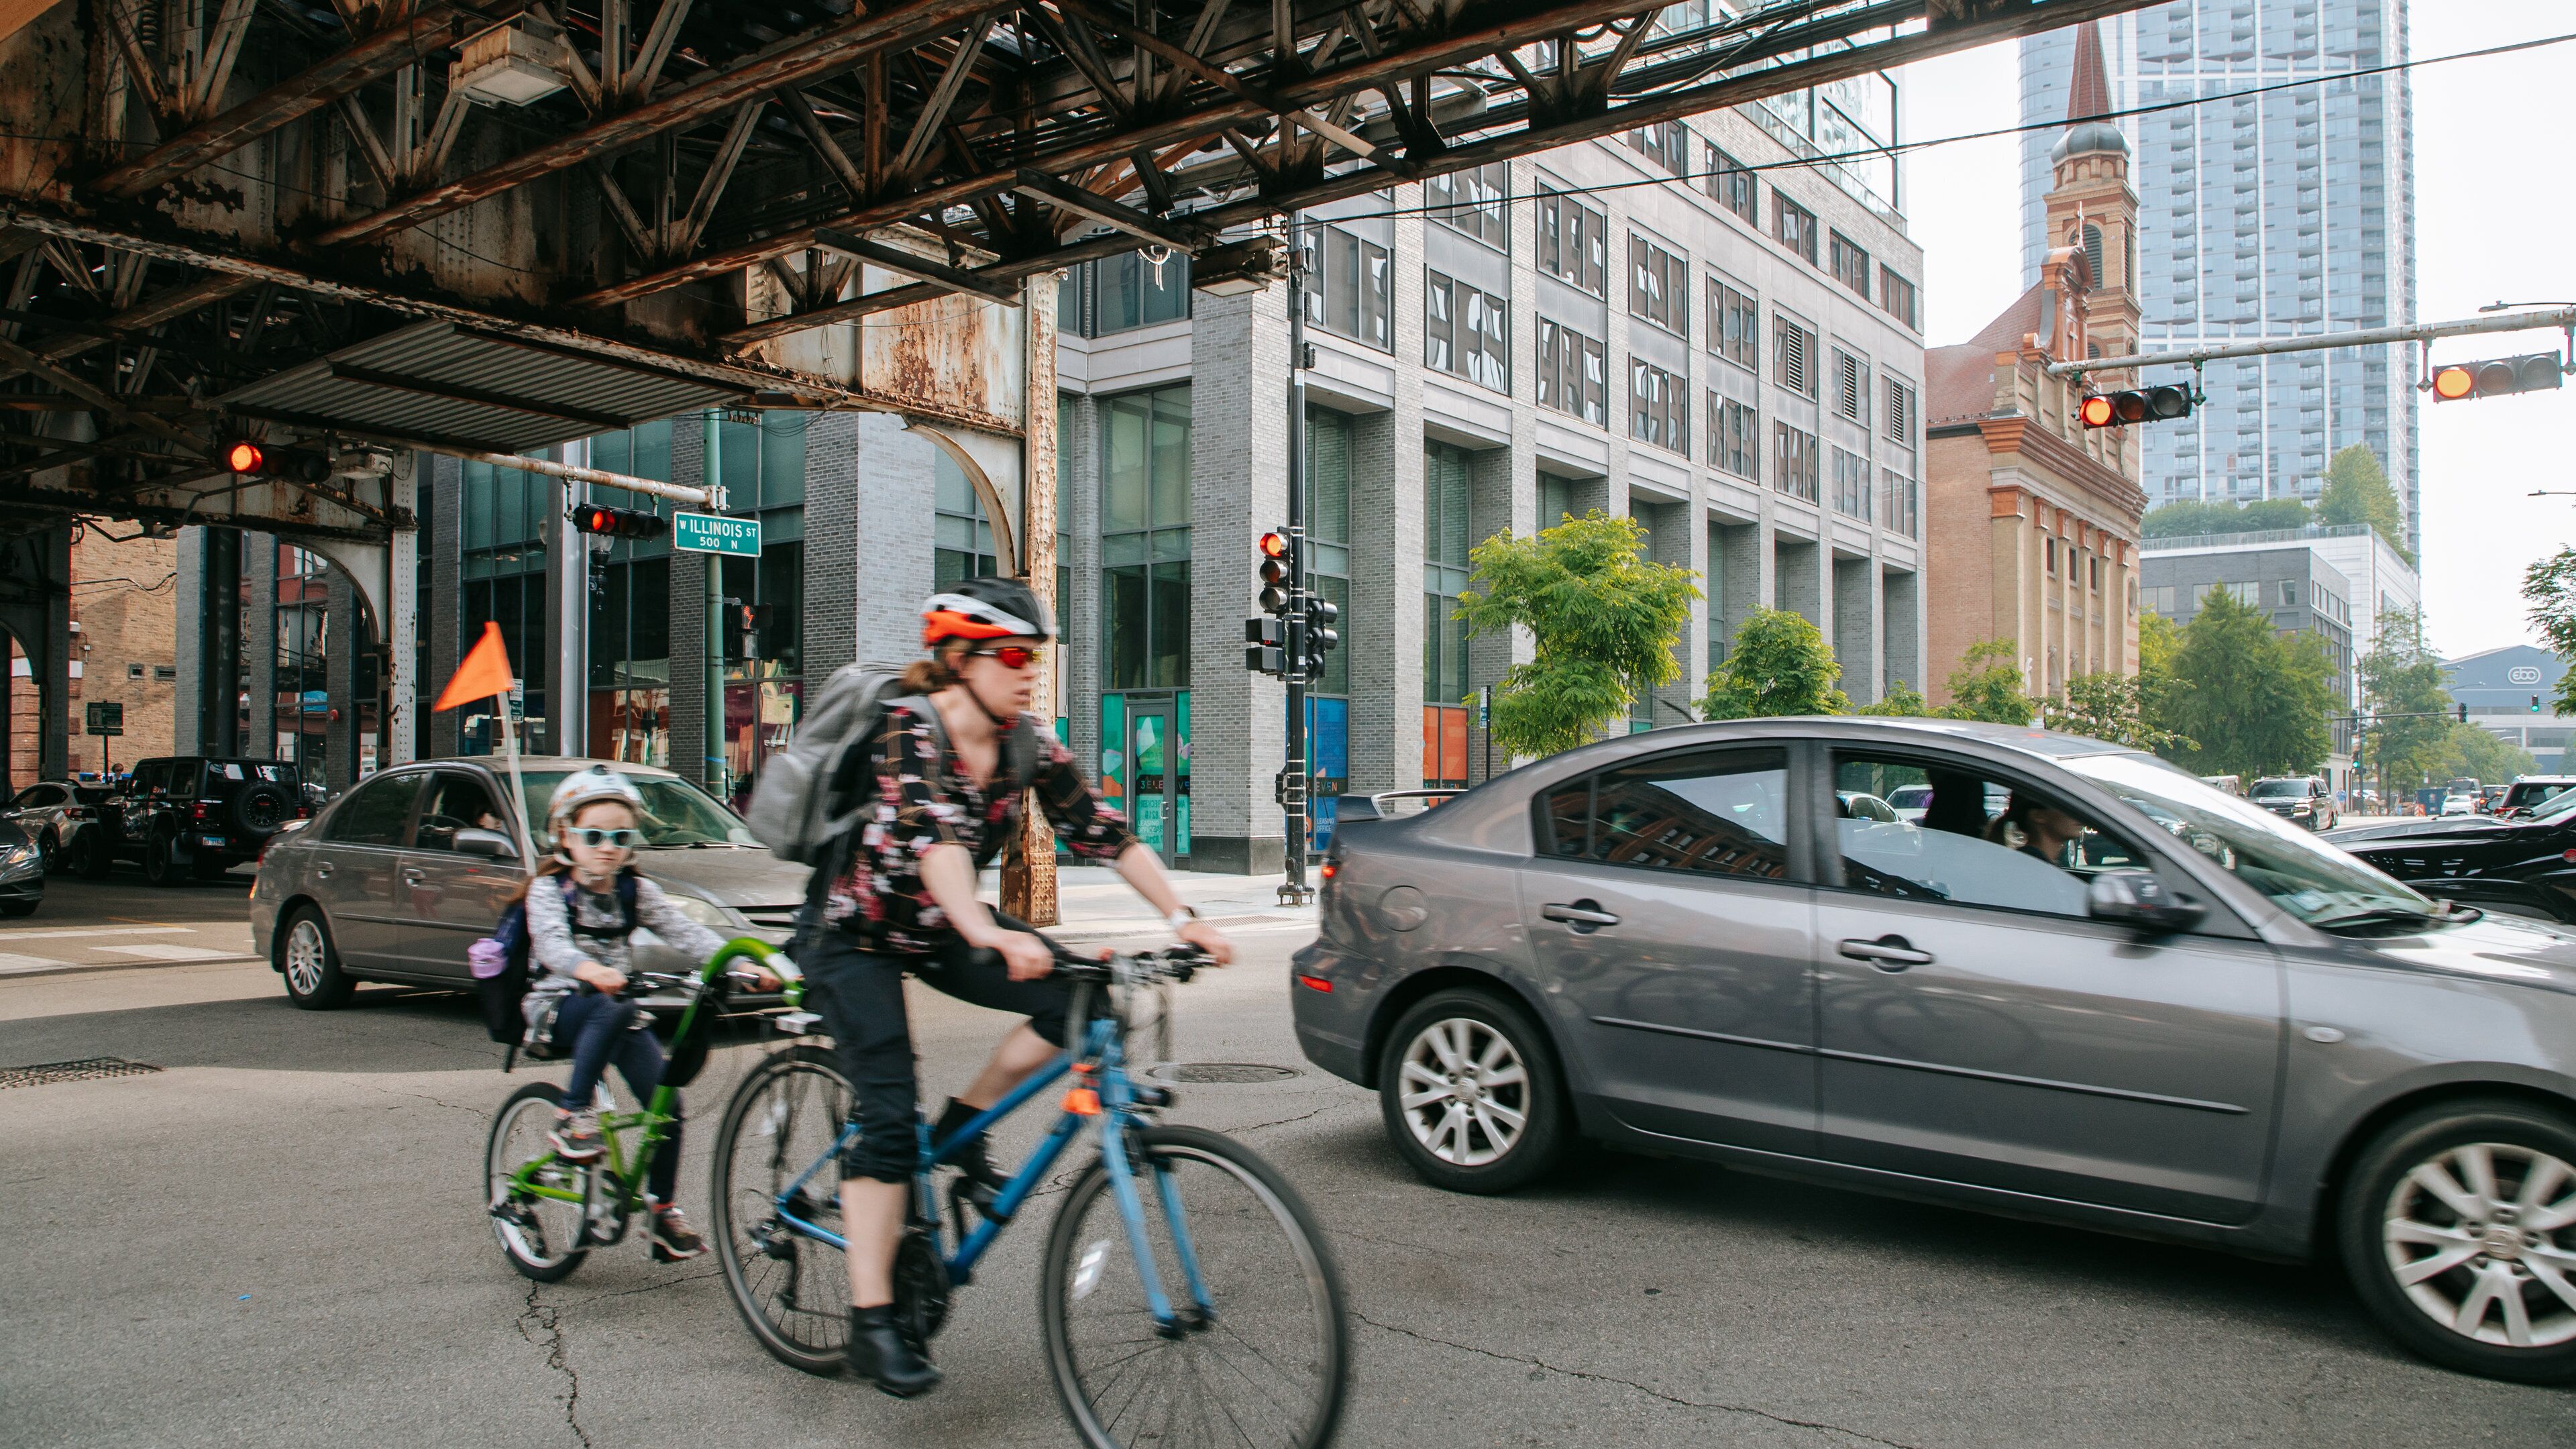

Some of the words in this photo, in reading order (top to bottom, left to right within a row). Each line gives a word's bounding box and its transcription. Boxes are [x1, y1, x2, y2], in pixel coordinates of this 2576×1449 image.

[680, 520, 686, 530] W
[690, 519, 743, 537] ILLINOIS
[746, 527, 756, 537] ST
[700, 537, 720, 547] 500
[731, 540, 738, 549] N
